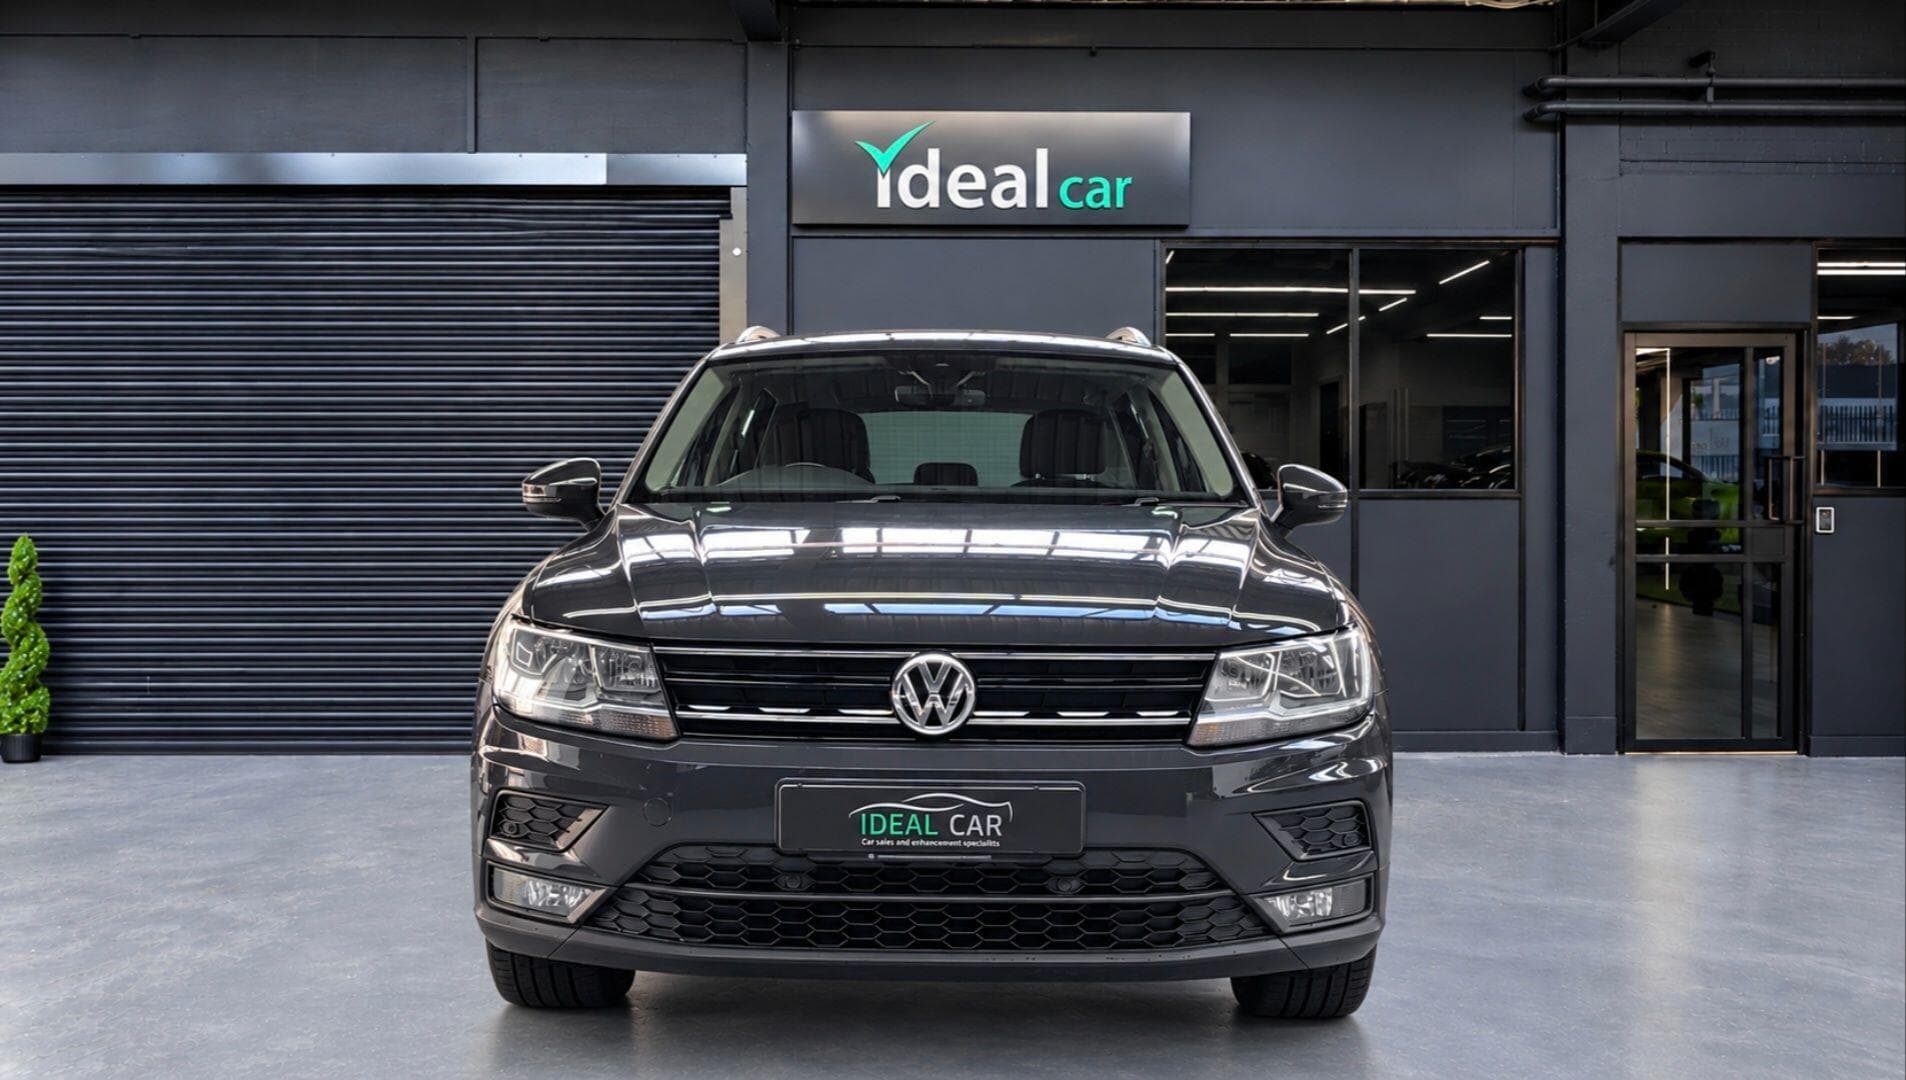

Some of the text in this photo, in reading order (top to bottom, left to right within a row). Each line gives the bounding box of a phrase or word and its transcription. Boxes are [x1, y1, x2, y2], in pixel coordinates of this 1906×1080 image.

[876, 148, 1132, 209] ideal car
[860, 813, 1002, 836] IDEAL CAR
[861, 838, 874, 846] Car
[875, 838, 894, 846] sales
[896, 838, 910, 846] and
[911, 839, 961, 847] enhancement
